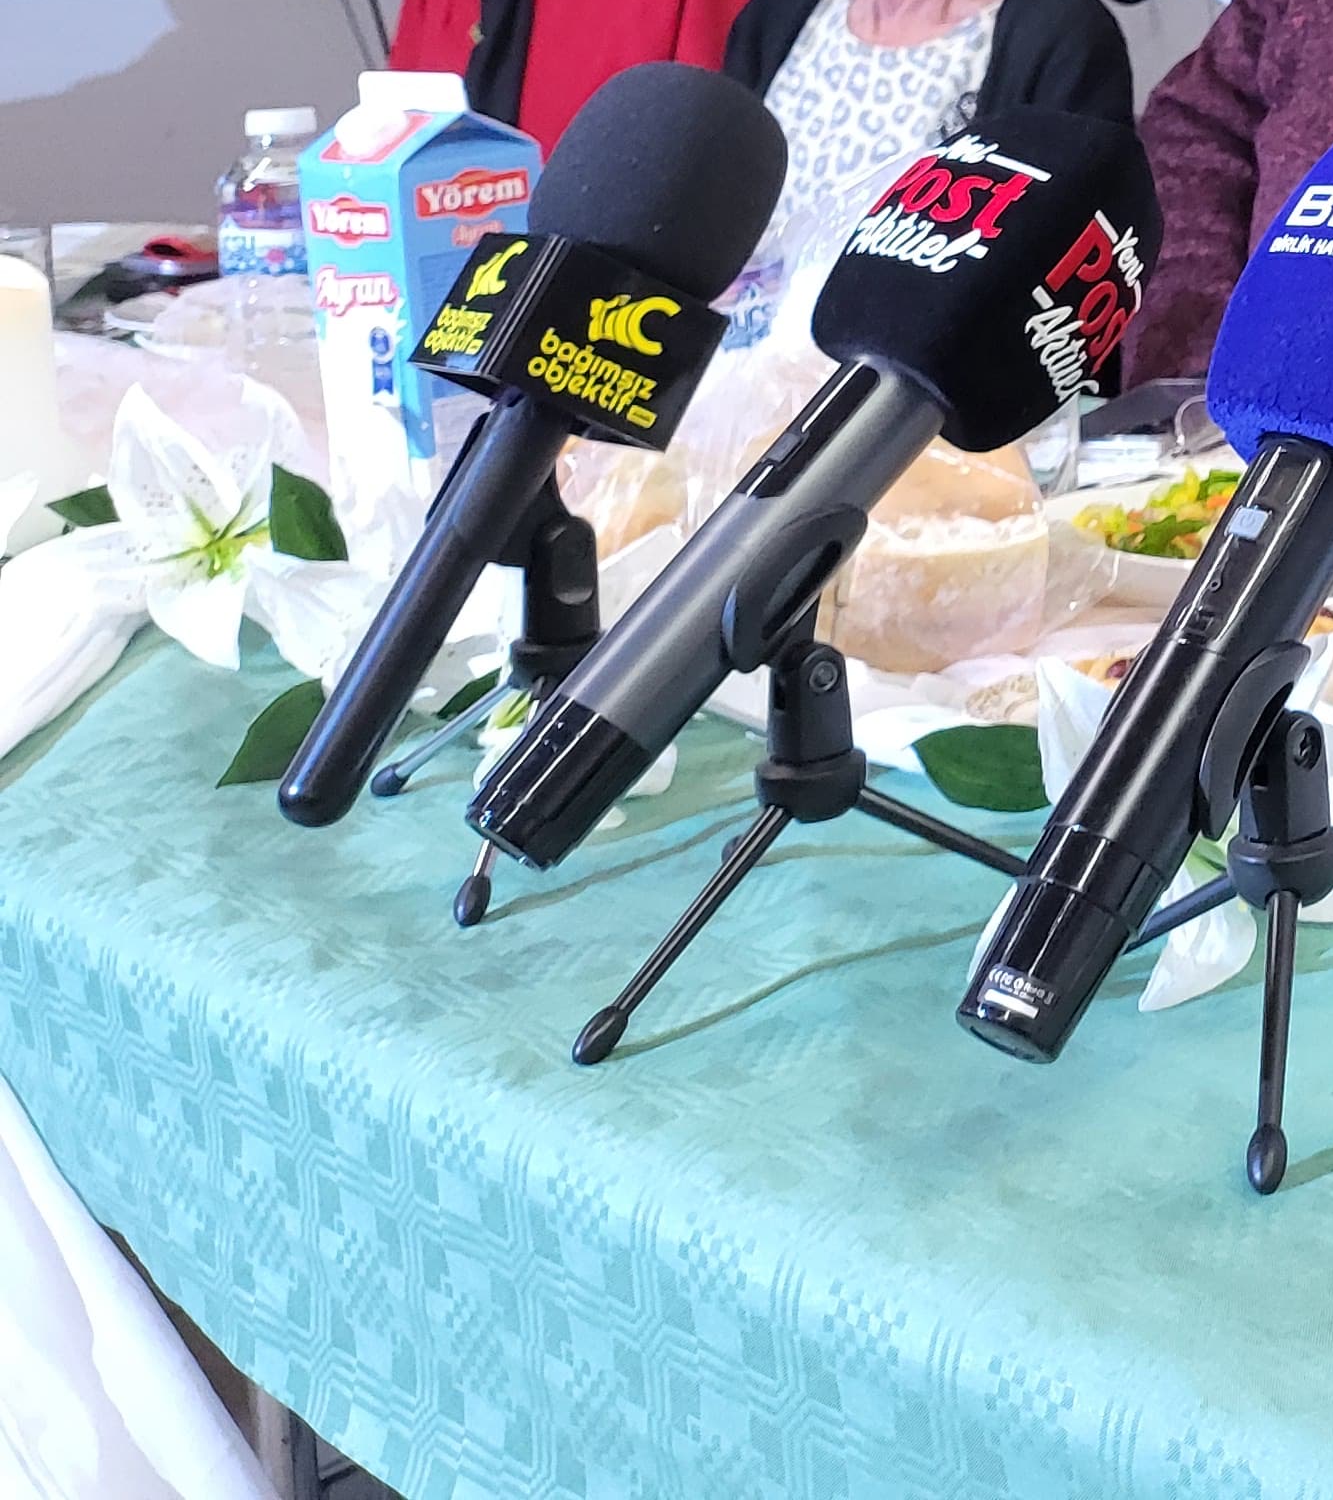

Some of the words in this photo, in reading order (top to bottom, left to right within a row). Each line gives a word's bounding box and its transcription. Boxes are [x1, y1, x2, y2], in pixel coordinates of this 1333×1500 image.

[421, 175, 525, 214] Yörem
[868, 155, 1034, 239] Post
[1268, 233, 1315, 254] BİRLİK
[1044, 217, 1140, 376] Pos
